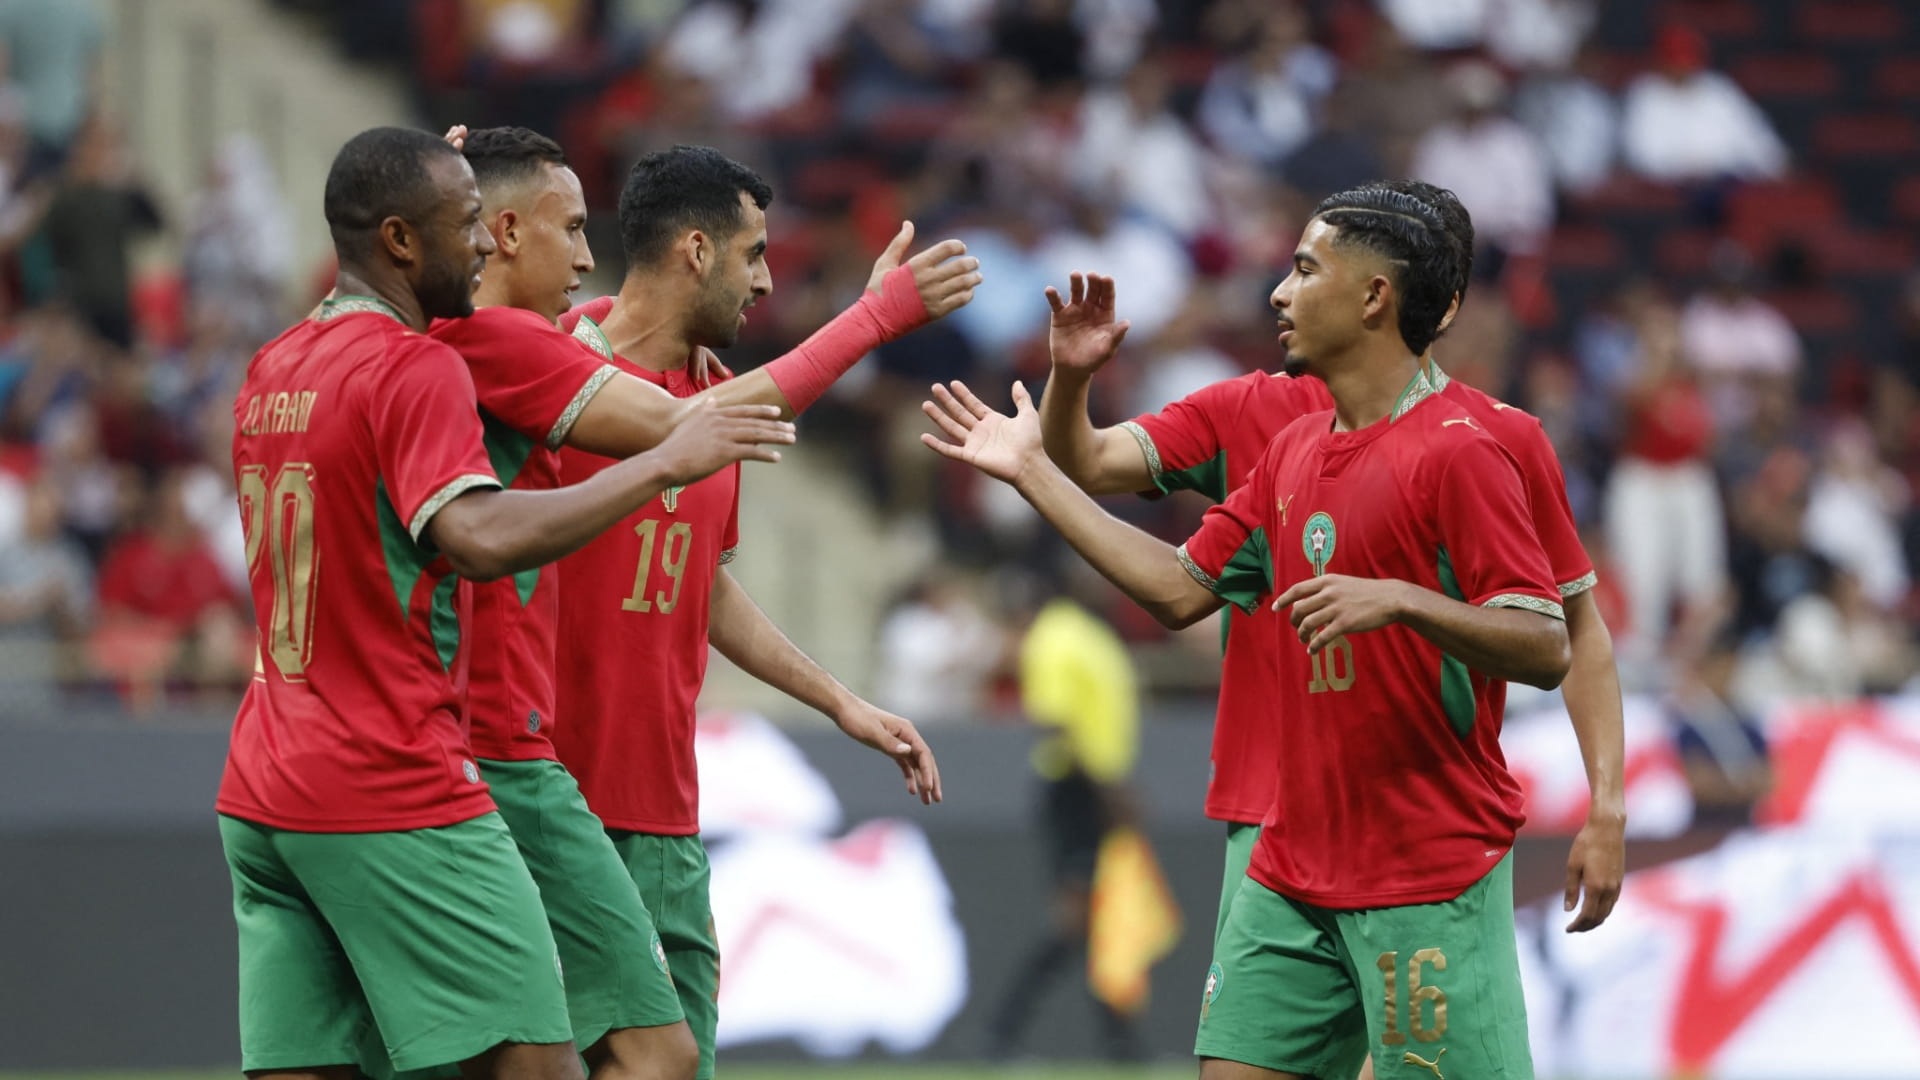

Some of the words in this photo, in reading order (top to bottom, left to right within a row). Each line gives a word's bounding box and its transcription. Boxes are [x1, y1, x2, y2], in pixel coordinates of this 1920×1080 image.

[261, 391, 318, 433] KAABI
[622, 519, 692, 614] 19
[1377, 948, 1447, 1045] 16
